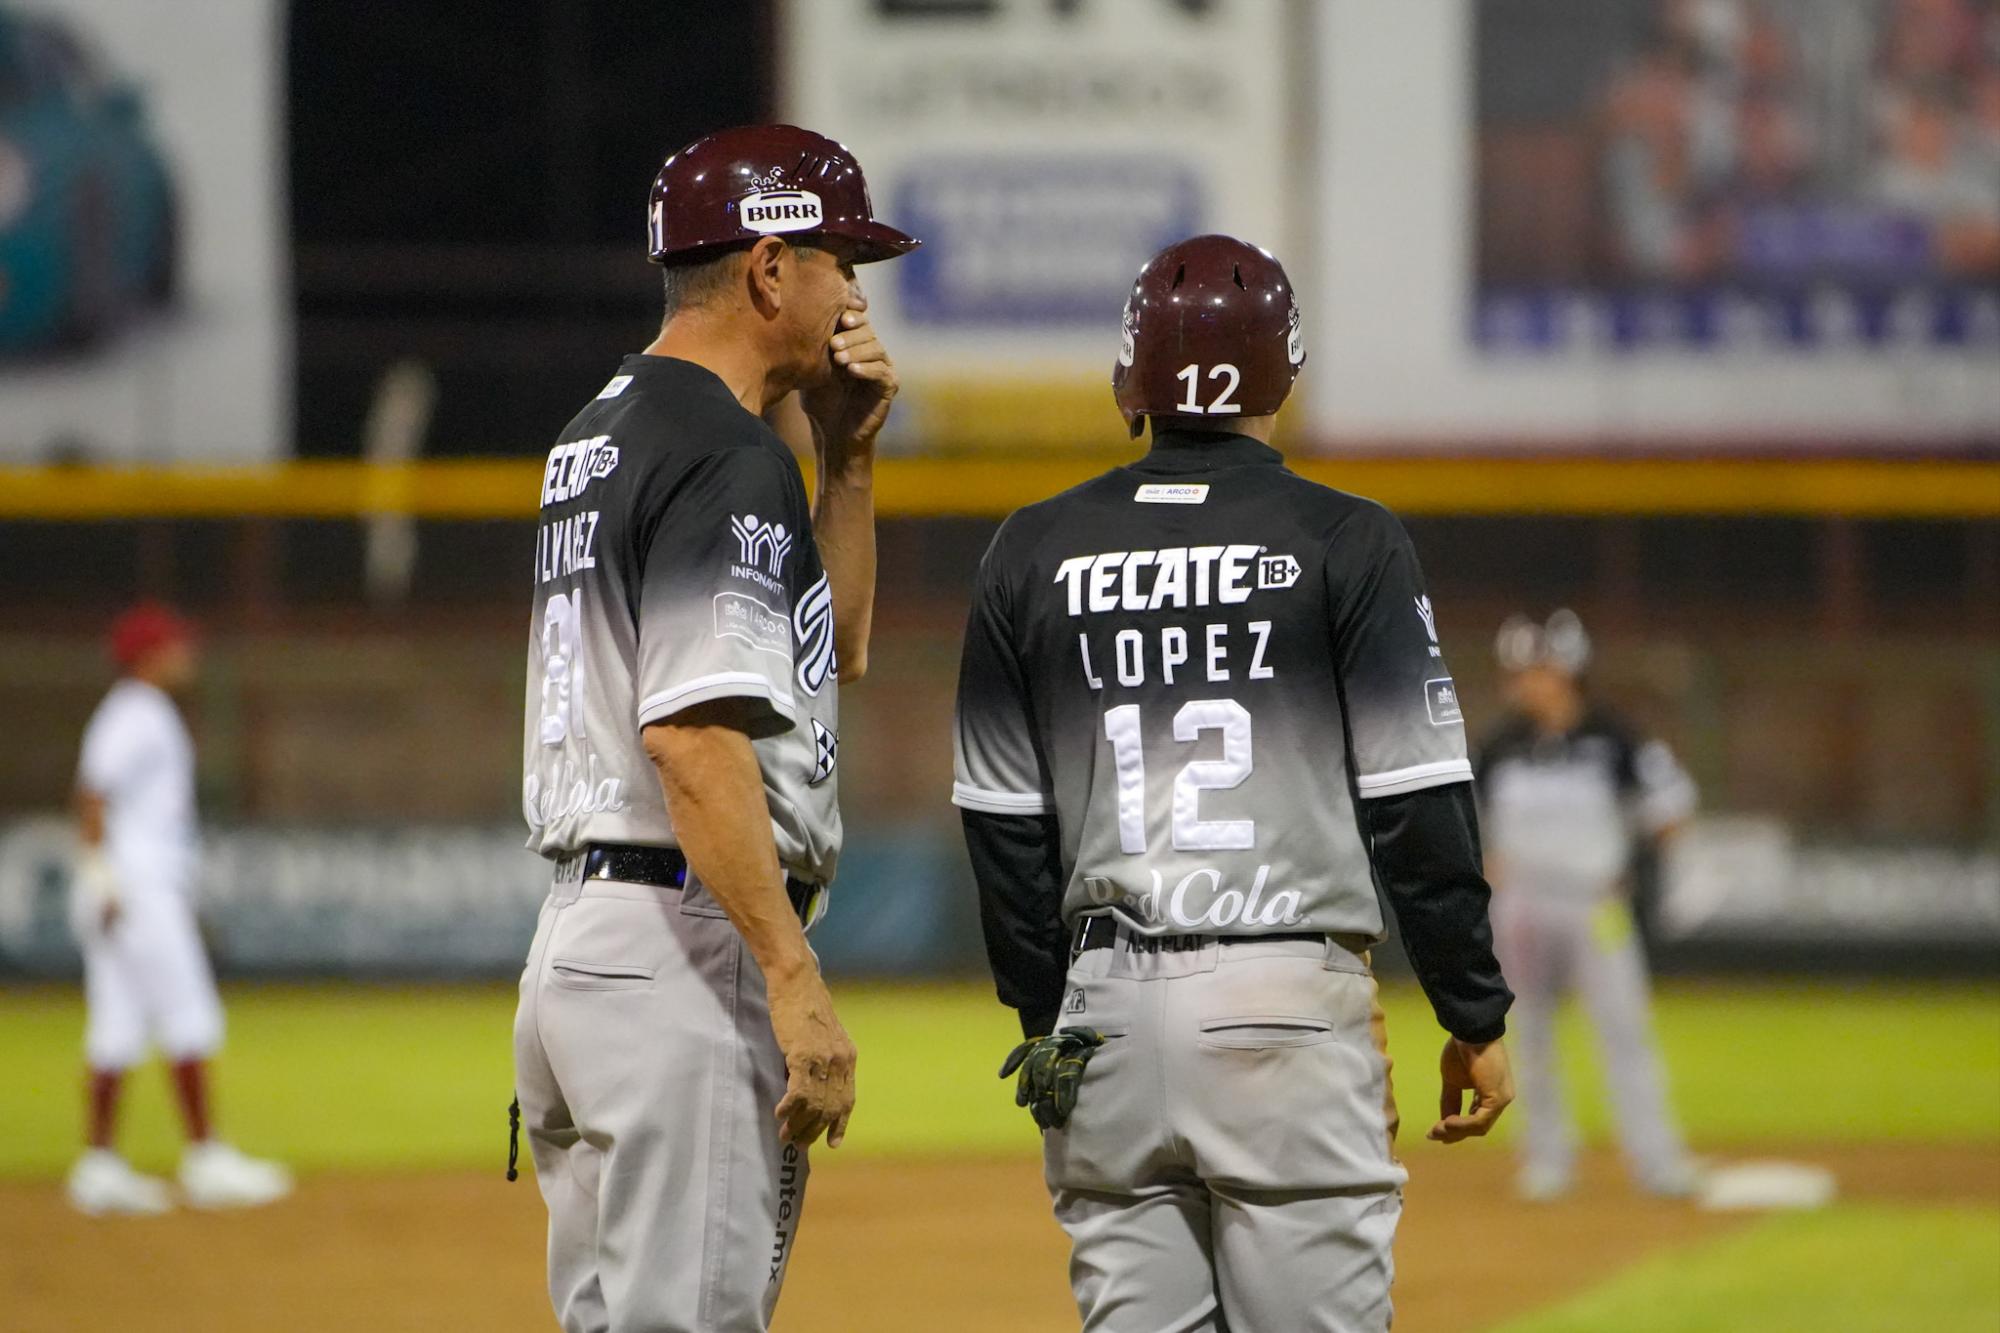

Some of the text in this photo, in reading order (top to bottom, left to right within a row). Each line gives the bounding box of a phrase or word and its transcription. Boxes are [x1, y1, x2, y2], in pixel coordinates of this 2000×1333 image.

[747, 203, 819, 222] BURR
[1176, 363, 1242, 415] 12
[731, 564, 785, 596] INFONAVIT
[1053, 544, 1301, 616] TECATE 18+
[1079, 620, 1275, 690] LOPEZ
[1104, 698, 1255, 854] 12
[1170, 865, 1303, 928] Cola
[769, 1138, 800, 1283] ente.mx
